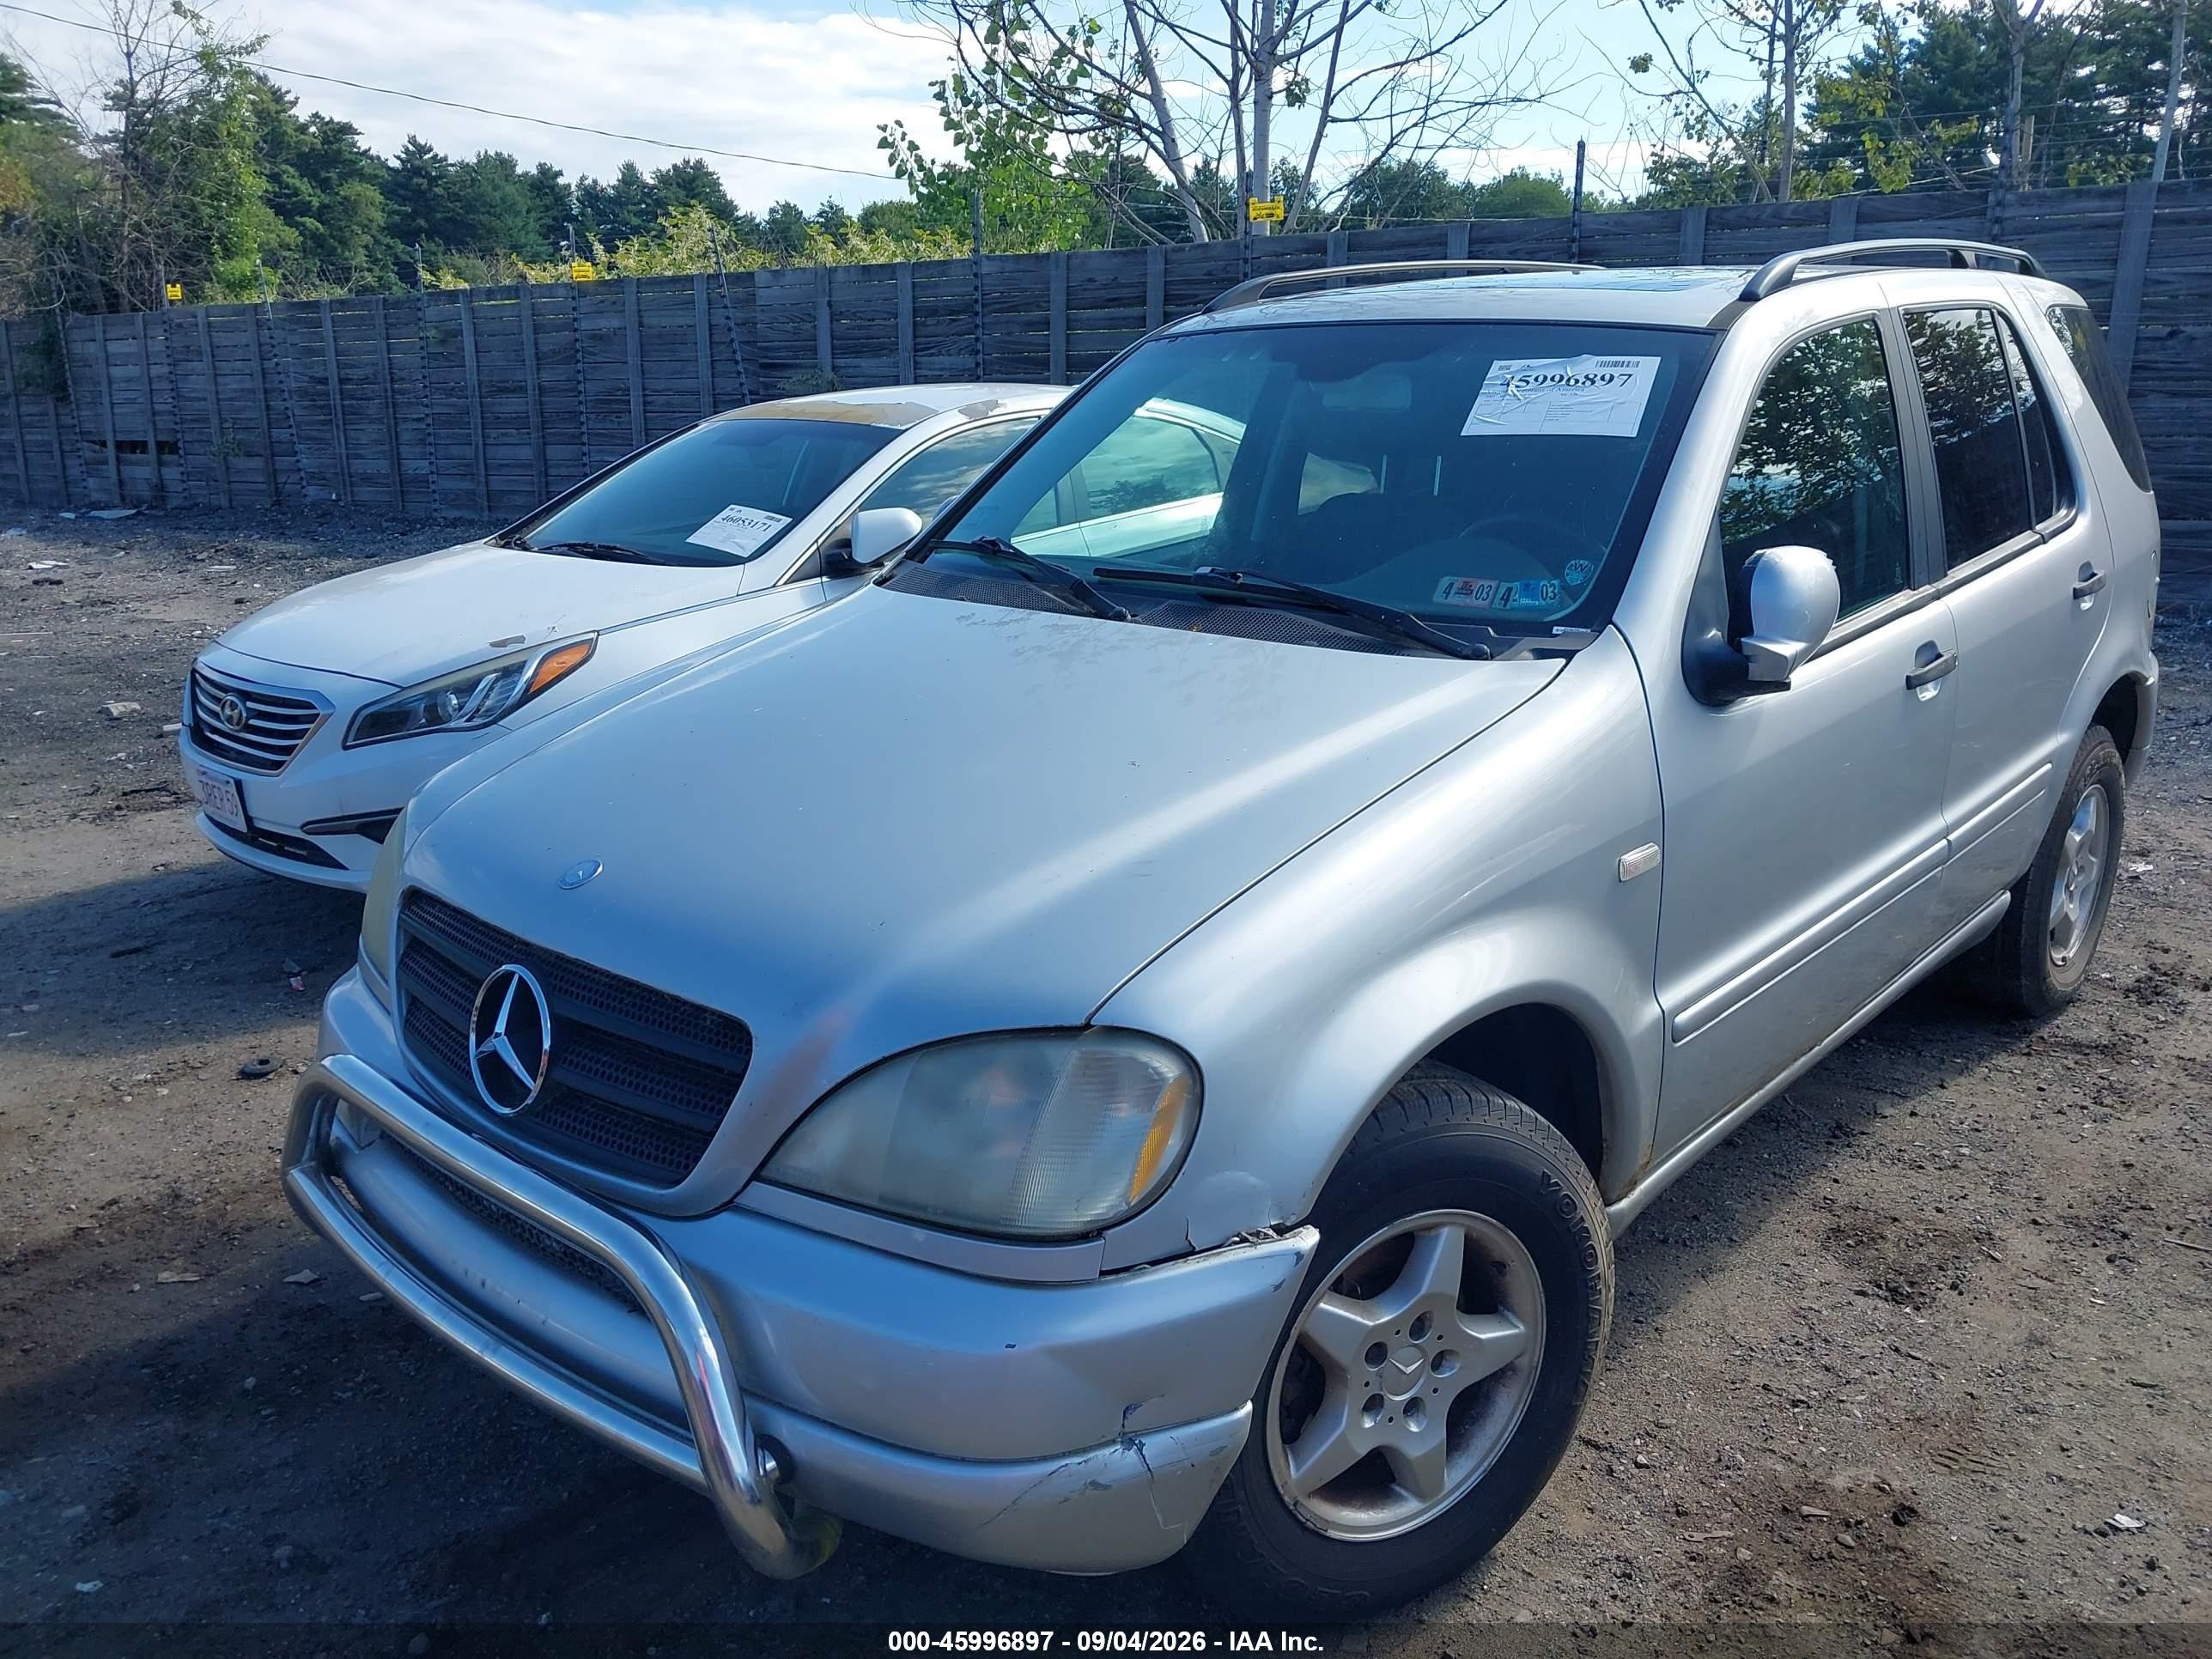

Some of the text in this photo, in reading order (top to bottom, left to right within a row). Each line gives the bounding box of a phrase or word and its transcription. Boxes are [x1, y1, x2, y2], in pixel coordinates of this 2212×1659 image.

[1499, 373, 1633, 388] 45996897
[720, 514, 772, 532] 46053171
[1474, 583, 1492, 601] 03
[1540, 583, 1558, 601] 03
